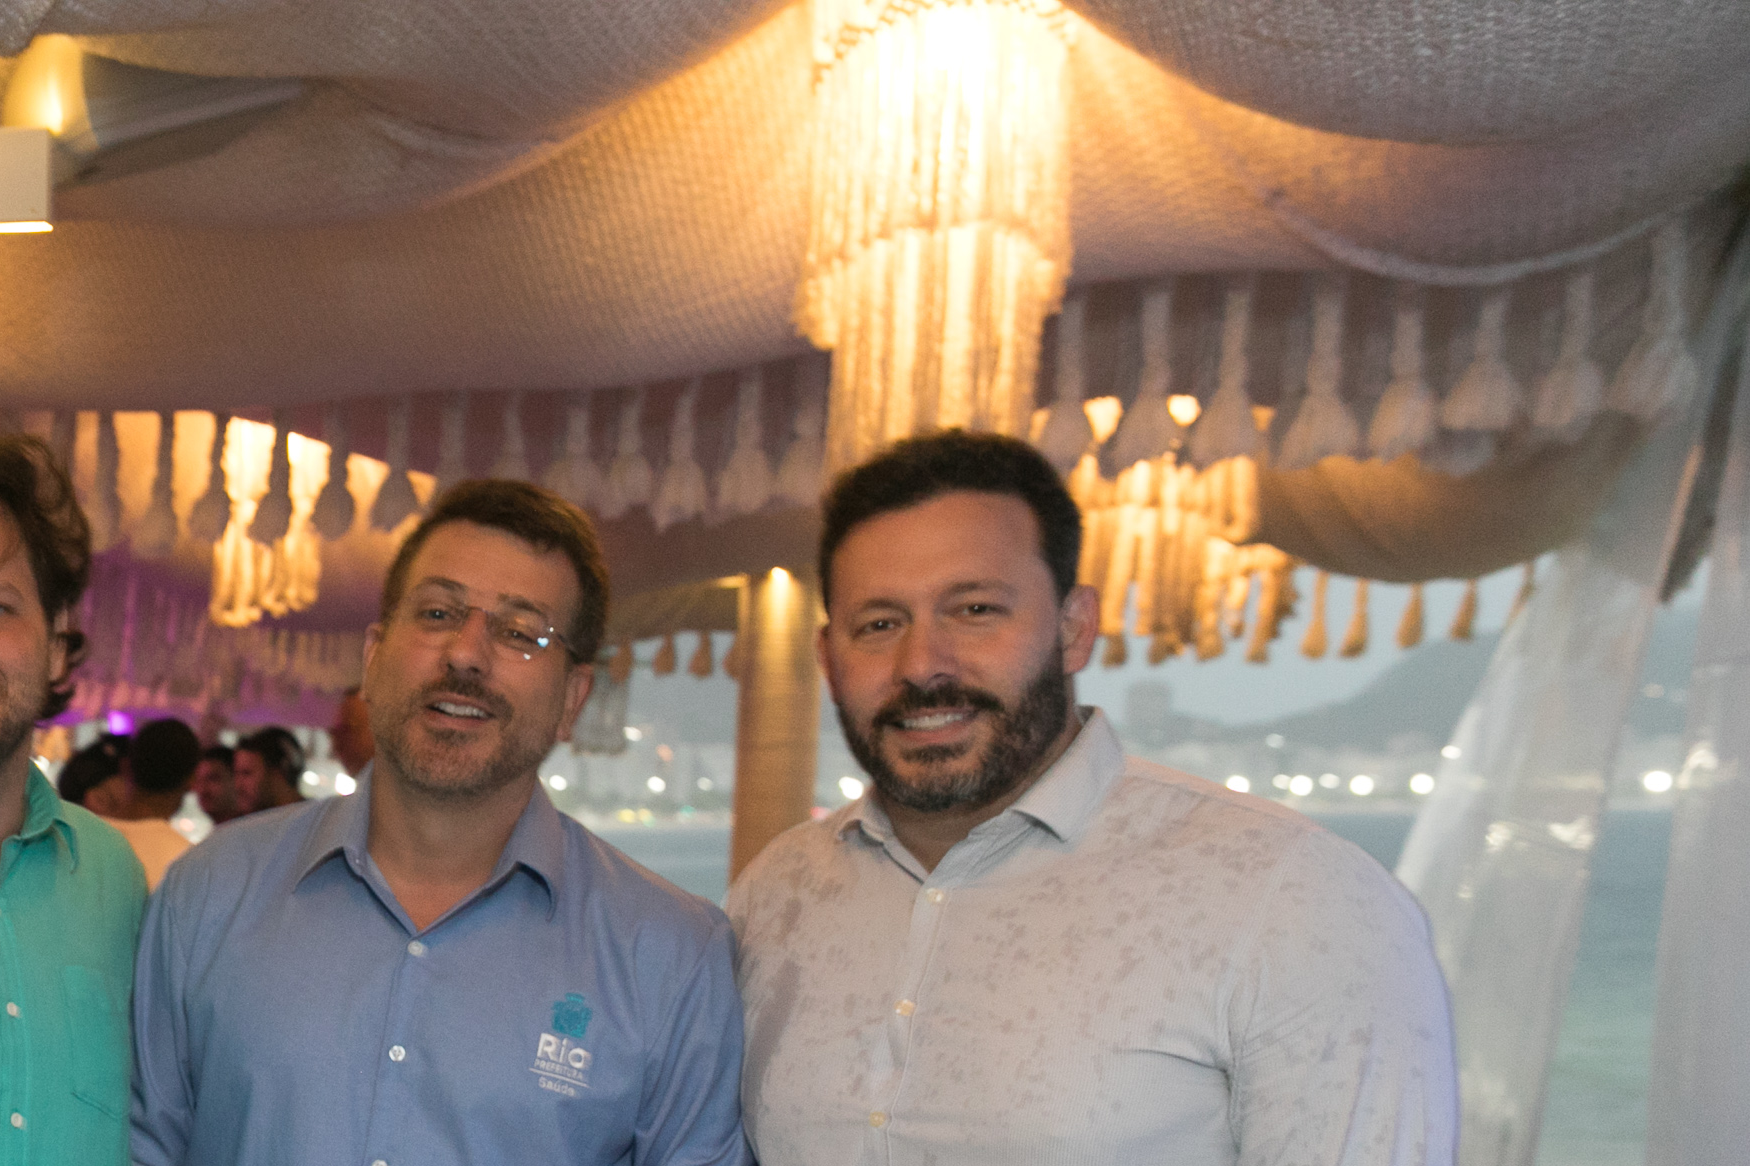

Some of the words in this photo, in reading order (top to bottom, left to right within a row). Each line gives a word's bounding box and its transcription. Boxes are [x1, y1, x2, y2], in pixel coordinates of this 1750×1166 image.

[536, 1032, 592, 1069] Rio
[534, 1058, 584, 1080] PREFEITURA
[538, 1075, 576, 1097] Saúde
